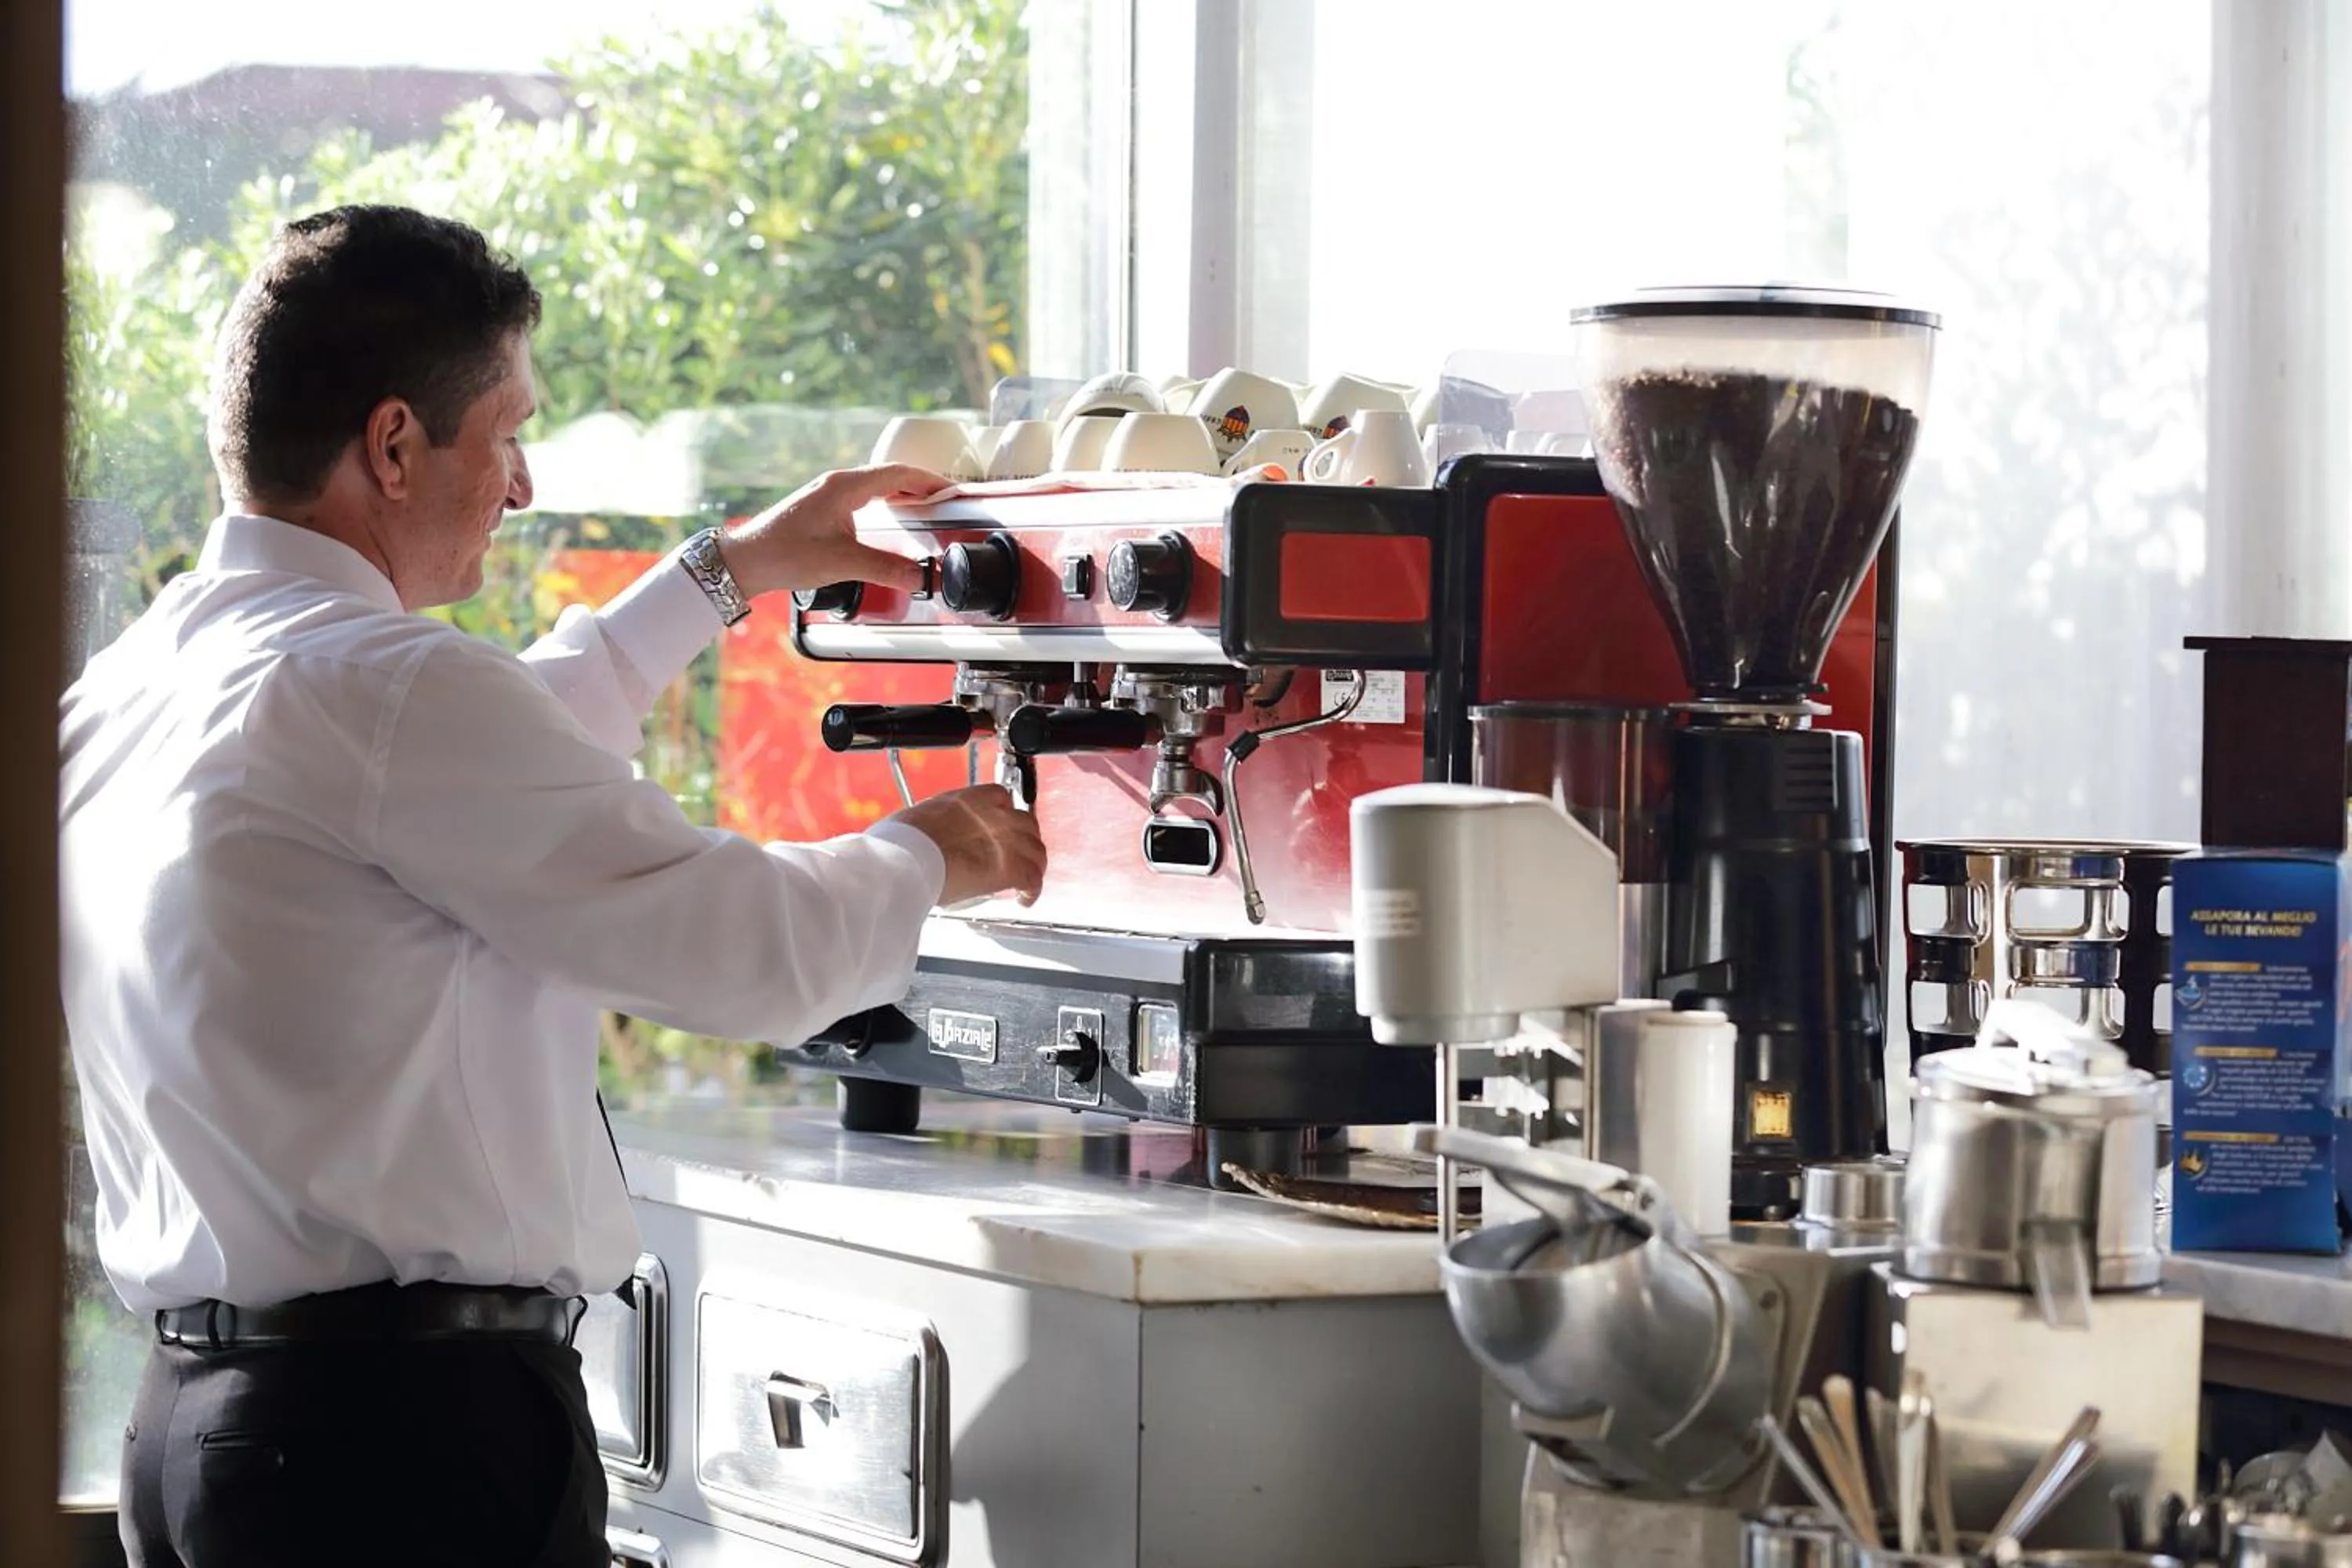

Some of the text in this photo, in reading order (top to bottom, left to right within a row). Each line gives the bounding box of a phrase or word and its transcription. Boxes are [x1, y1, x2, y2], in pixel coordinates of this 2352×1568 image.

[2191, 909, 2317, 923] ASSAPORA AL MEGLIO
[2205, 924, 2218, 935] LE
[2221, 924, 2242, 936] TUE
